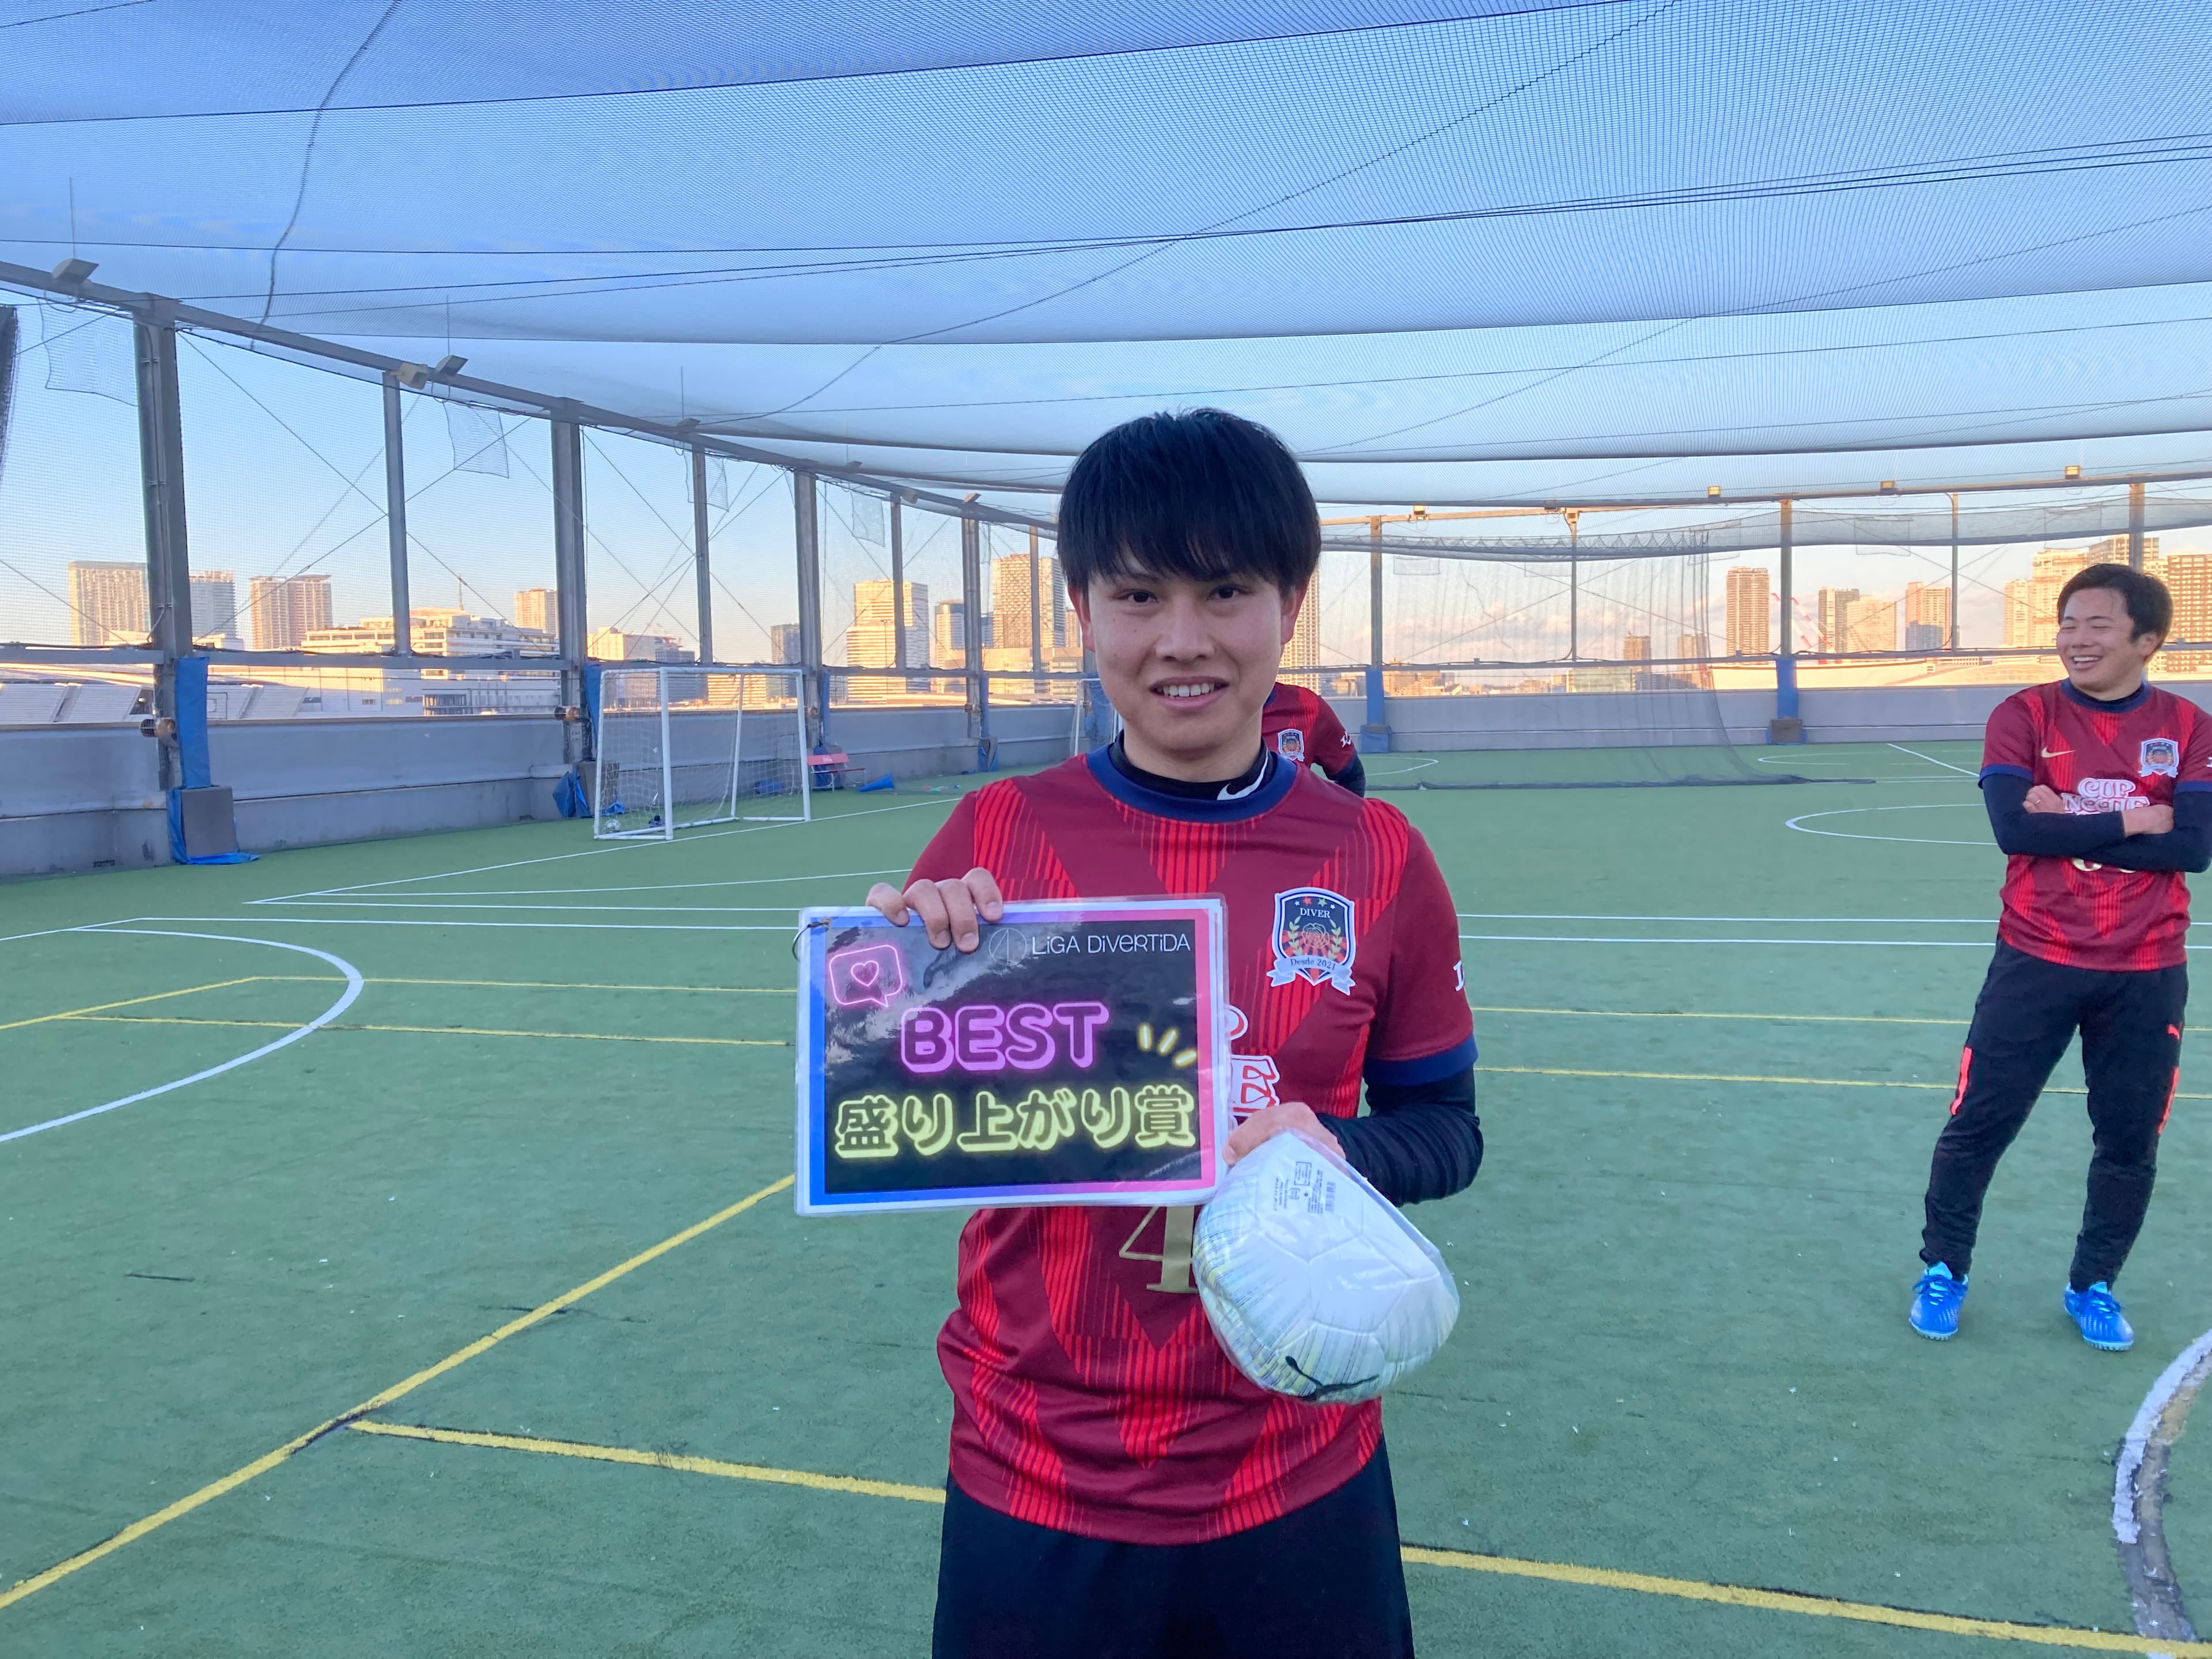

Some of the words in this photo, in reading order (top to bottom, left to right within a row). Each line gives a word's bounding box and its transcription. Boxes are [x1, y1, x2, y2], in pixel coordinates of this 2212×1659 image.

[2078, 778, 2136, 798] CUP
[1300, 907, 1331, 919] DIVER
[1290, 957, 1315, 967] Desde
[1317, 959, 1336, 971] 2021
[900, 1002, 1109, 1073] BEST
[835, 1084, 1196, 1158] 盛り上がり賞
